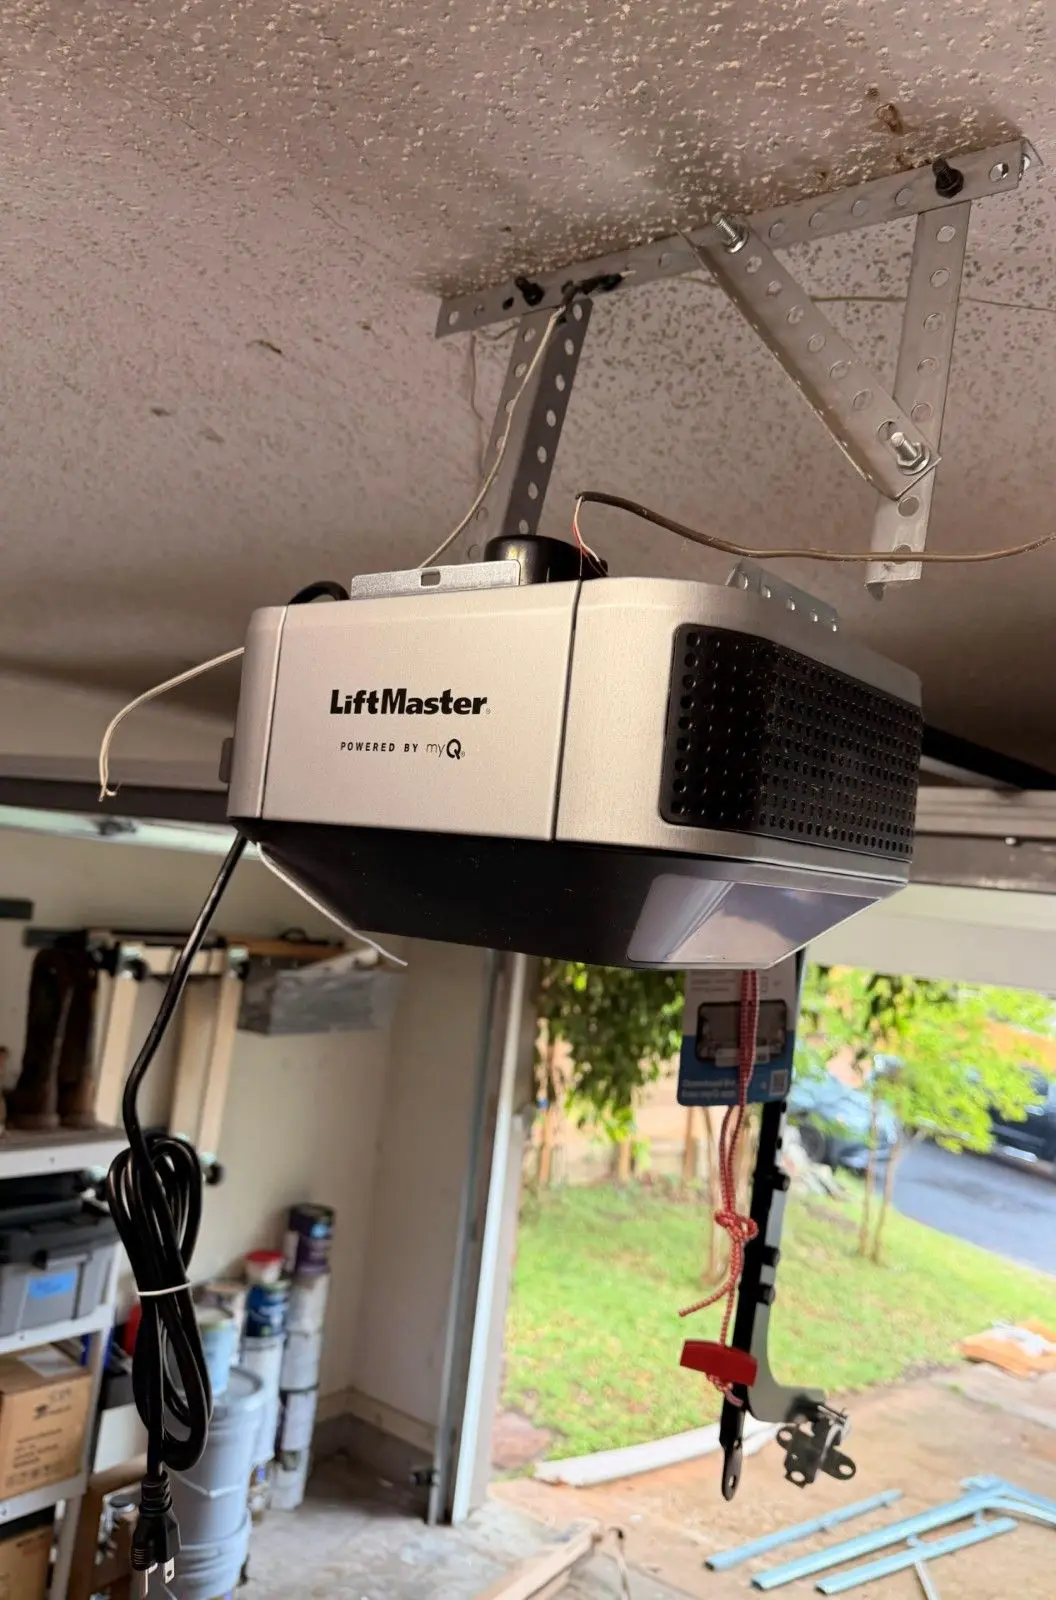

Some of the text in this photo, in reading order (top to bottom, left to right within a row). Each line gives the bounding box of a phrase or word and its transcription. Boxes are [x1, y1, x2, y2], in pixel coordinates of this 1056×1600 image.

[329, 688, 488, 715] LiftMaster
[340, 741, 396, 752] POWERED
[403, 743, 419, 753] BY
